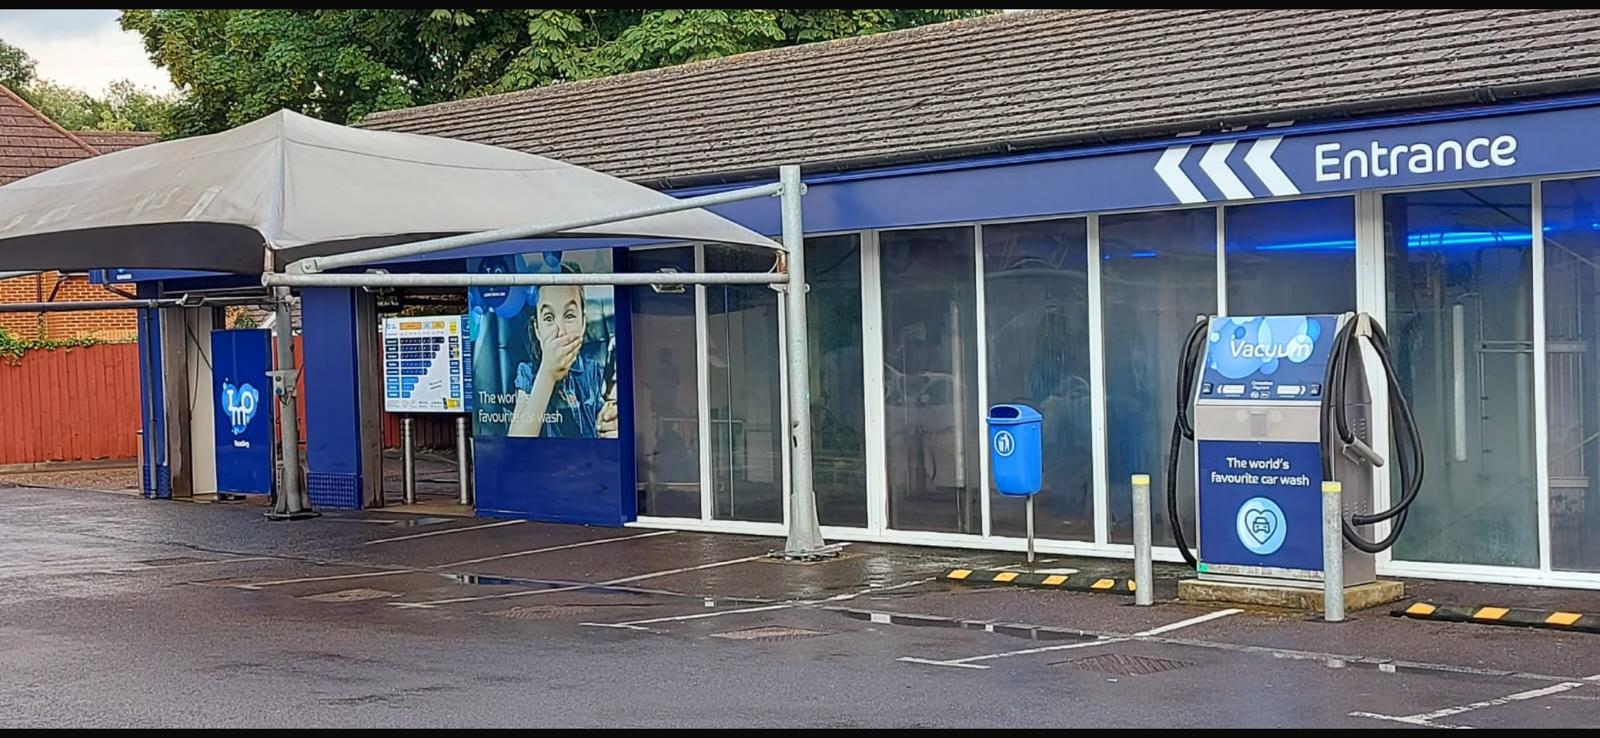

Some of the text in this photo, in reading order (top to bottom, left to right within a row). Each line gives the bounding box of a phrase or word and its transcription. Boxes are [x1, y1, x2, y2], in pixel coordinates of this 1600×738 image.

[1315, 134, 1518, 182] Entrance
[1230, 340, 1311, 358] Vacuum
[478, 391, 497, 404] The
[478, 409, 521, 423] favourit
[537, 410, 563, 423] wash
[1226, 457, 1290, 470] The world's
[1211, 471, 1310, 487] favourite car wash
